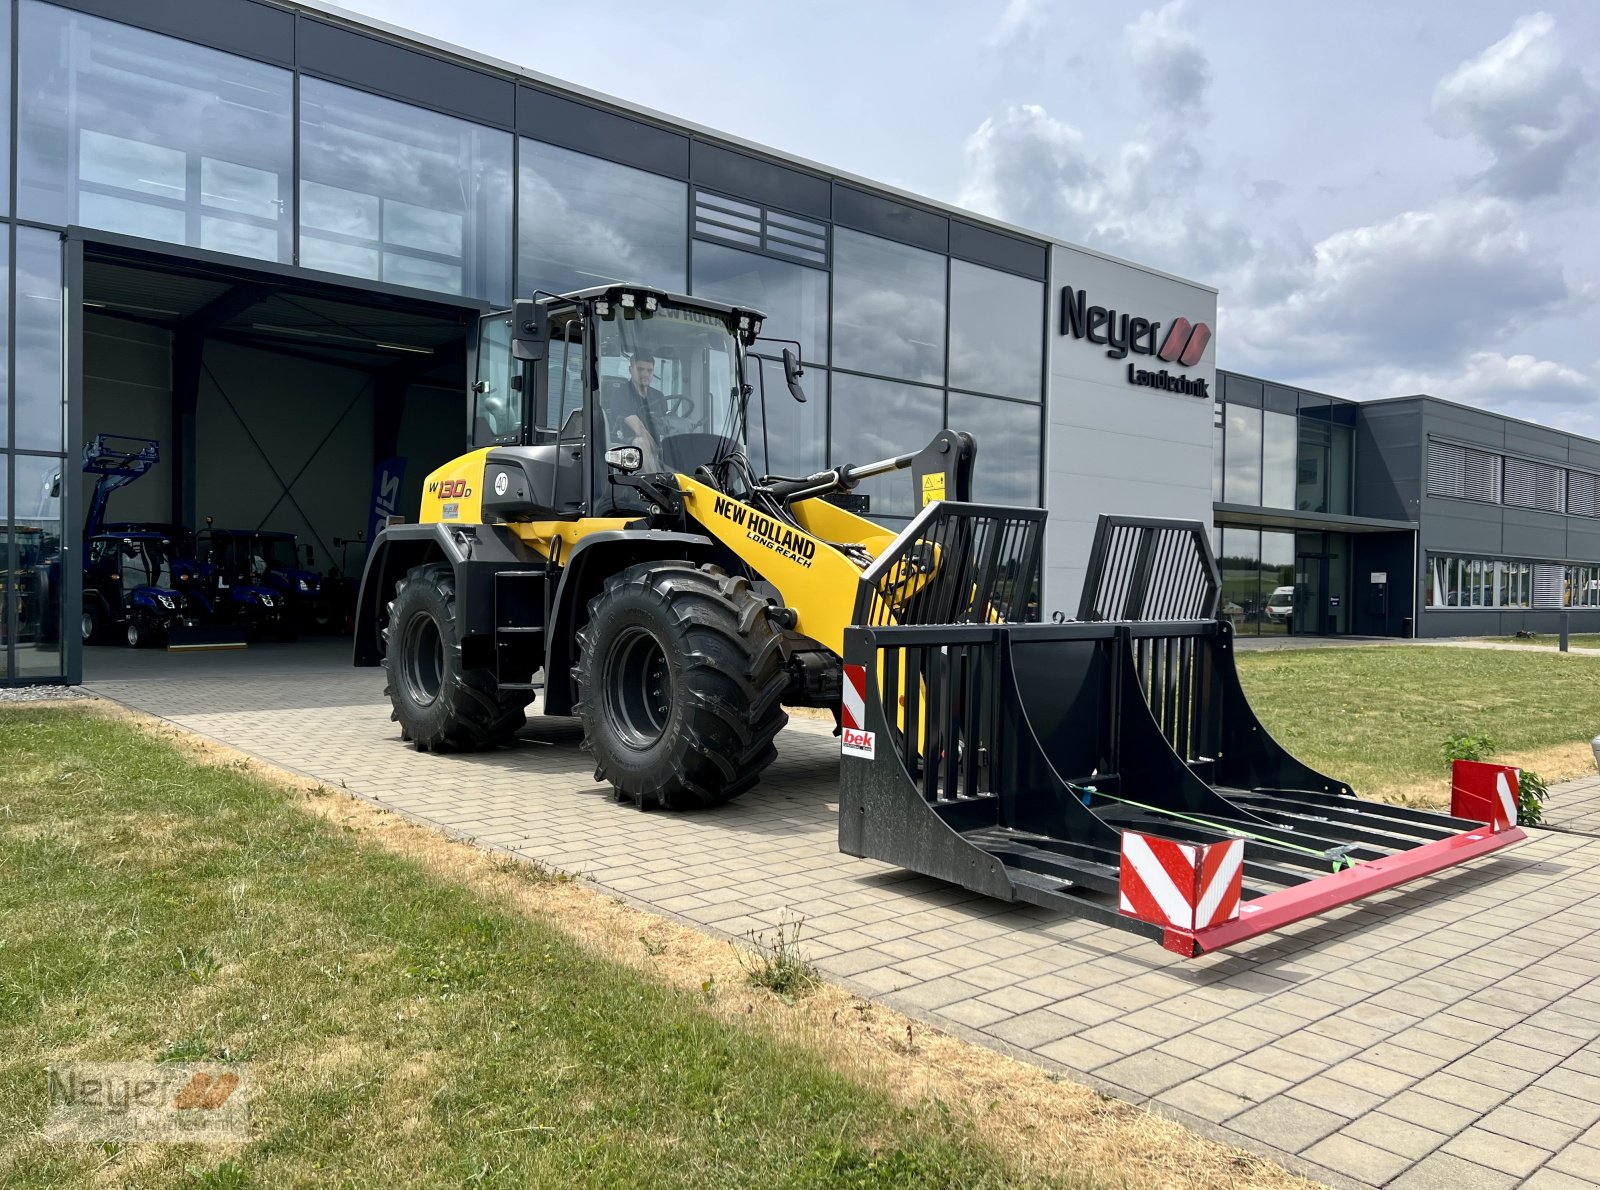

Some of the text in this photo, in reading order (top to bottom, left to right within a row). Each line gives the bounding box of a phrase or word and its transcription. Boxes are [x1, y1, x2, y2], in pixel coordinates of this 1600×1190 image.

[1060, 285, 1160, 359] Neyer
[1128, 363, 1209, 398] Landtechnik
[496, 476, 507, 492] 40
[714, 496, 815, 560] NEW HOLLAND
[747, 532, 812, 568] LONG REACH
[844, 729, 872, 747] bek
